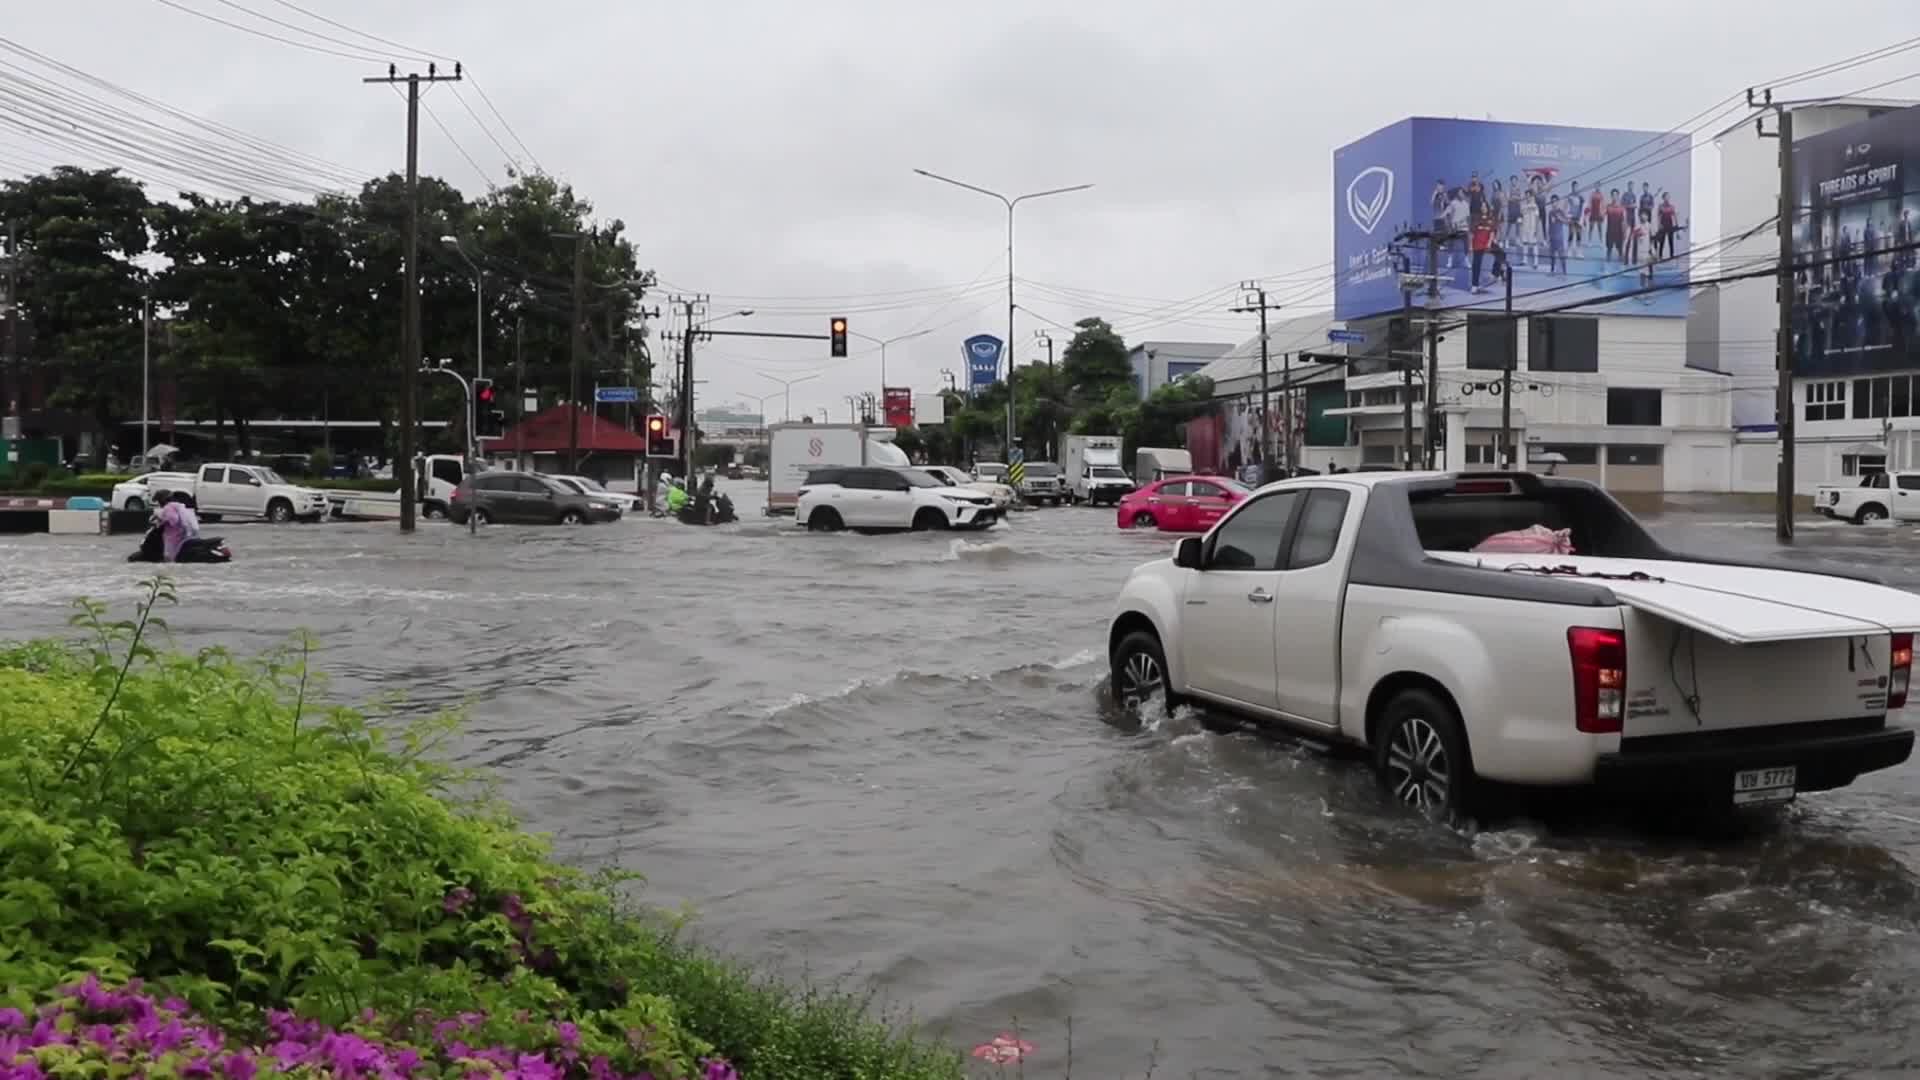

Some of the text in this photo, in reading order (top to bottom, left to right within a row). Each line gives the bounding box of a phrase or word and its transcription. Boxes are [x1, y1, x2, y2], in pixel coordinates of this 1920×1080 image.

[1512, 141, 1560, 158] THREADS
[1819, 173, 1858, 197] THREADS
[1867, 164, 1897, 185] SPIRIT
